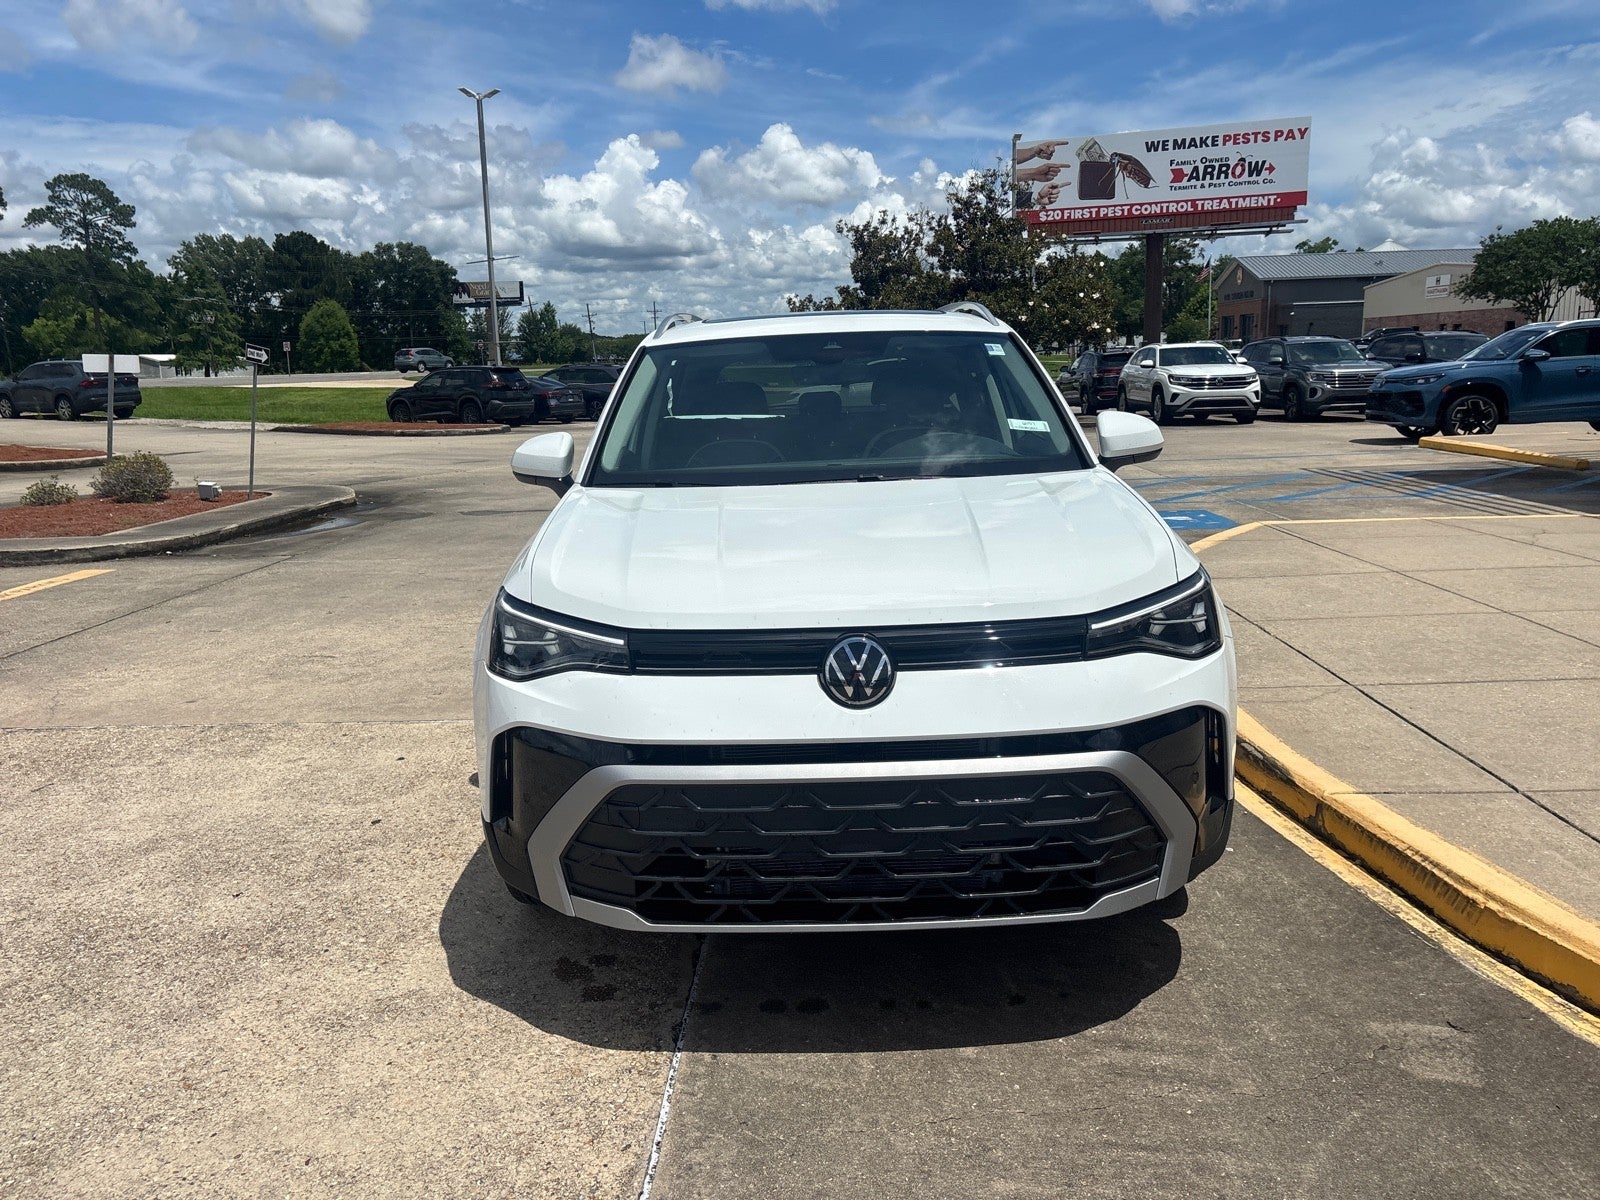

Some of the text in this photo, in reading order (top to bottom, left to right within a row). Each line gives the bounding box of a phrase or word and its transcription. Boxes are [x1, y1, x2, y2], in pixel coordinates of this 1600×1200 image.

[1145, 127, 1310, 153] WE MAKE PESTS PAY
[1170, 156, 1231, 168] FAMILY OWNED
[1187, 159, 1267, 183] ARROW
[1169, 184, 1198, 192] TERMITE
[1208, 181, 1226, 189] PEST
[1228, 179, 1261, 188] CONTROL
[1039, 210, 1062, 222] $20
[1064, 208, 1097, 220] FIRST
[1099, 205, 1131, 217] PEST
[1132, 201, 1194, 216] CONTROL
